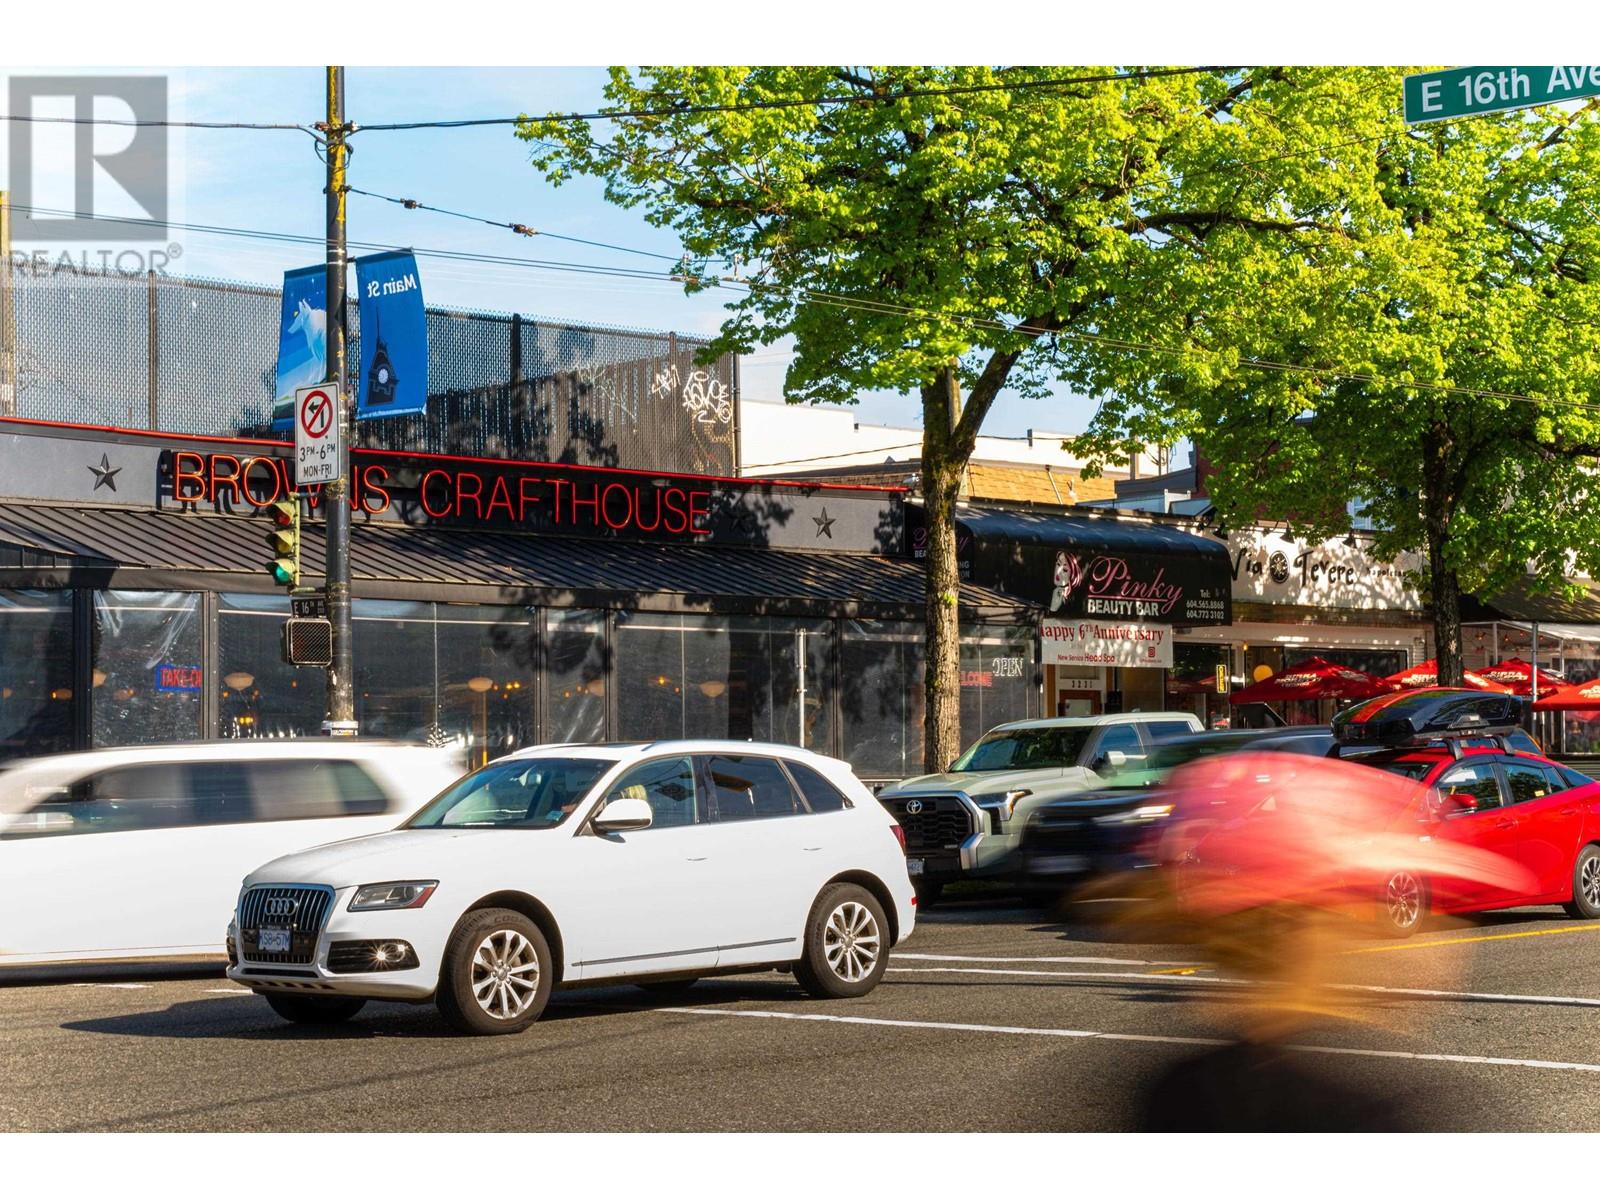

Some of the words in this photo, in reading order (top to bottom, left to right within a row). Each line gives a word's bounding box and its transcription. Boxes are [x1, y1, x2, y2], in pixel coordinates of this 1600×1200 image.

[1421, 80, 1443, 113] E
[1458, 67, 1530, 107] 16th
[421, 469, 712, 535] CRAFTHOUSE
[1294, 550, 1354, 586] Tevere
[1088, 555, 1184, 615] Pinky
[1087, 599, 1133, 616] BEAUTY
[1136, 603, 1159, 616] BAR
[1093, 625, 1164, 645] Anniversary
[992, 657, 1024, 677] OPEN
[1103, 653, 1116, 664] Spa
